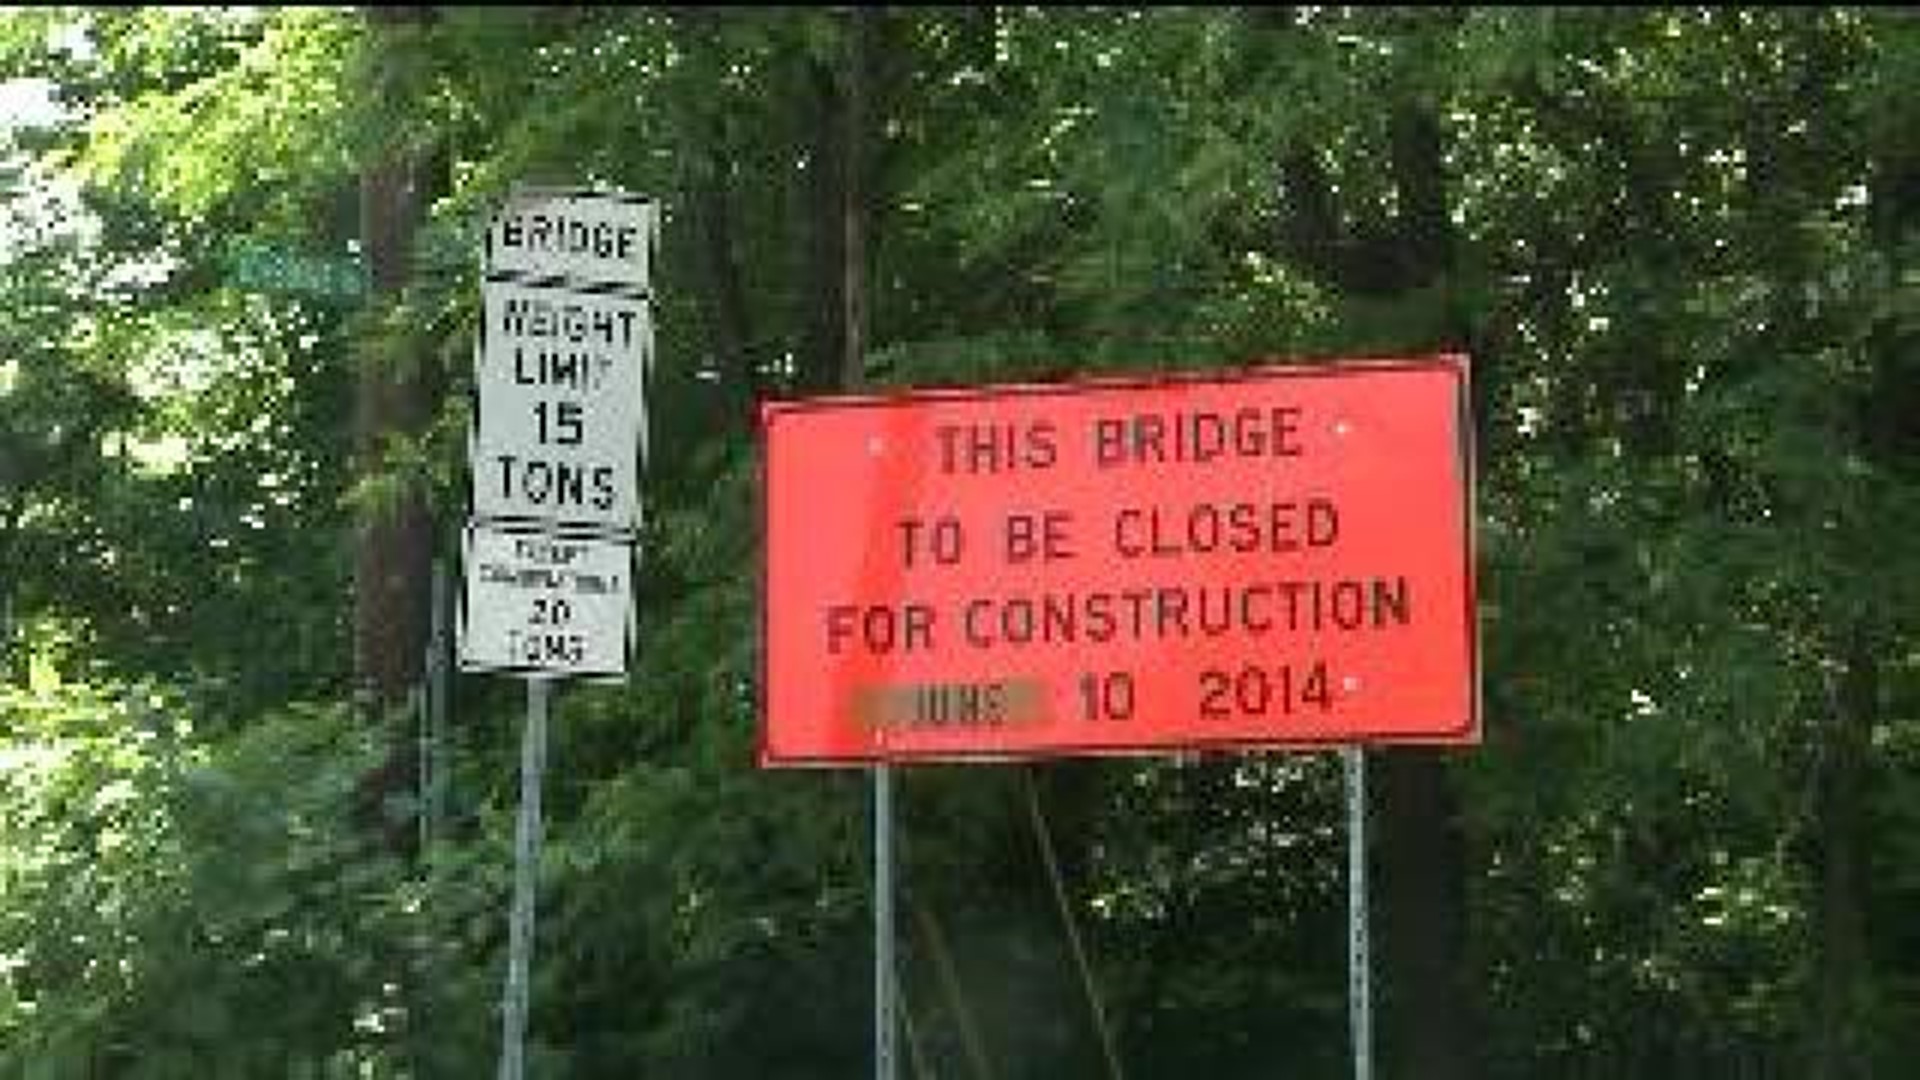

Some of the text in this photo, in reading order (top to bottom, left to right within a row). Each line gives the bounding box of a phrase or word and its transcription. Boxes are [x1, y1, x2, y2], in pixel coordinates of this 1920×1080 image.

[504, 216, 637, 258] BRIDGE
[504, 300, 637, 348] WEIGHT
[533, 402, 583, 444] 15
[935, 407, 1302, 474] THIS BRIDGE
[498, 456, 613, 510] TONS
[895, 498, 1338, 568] TO BE CLOSED
[827, 577, 1409, 654] FOR CONSTRUCTION
[1080, 671, 1134, 720] 10
[1199, 661, 1332, 719] 2014
